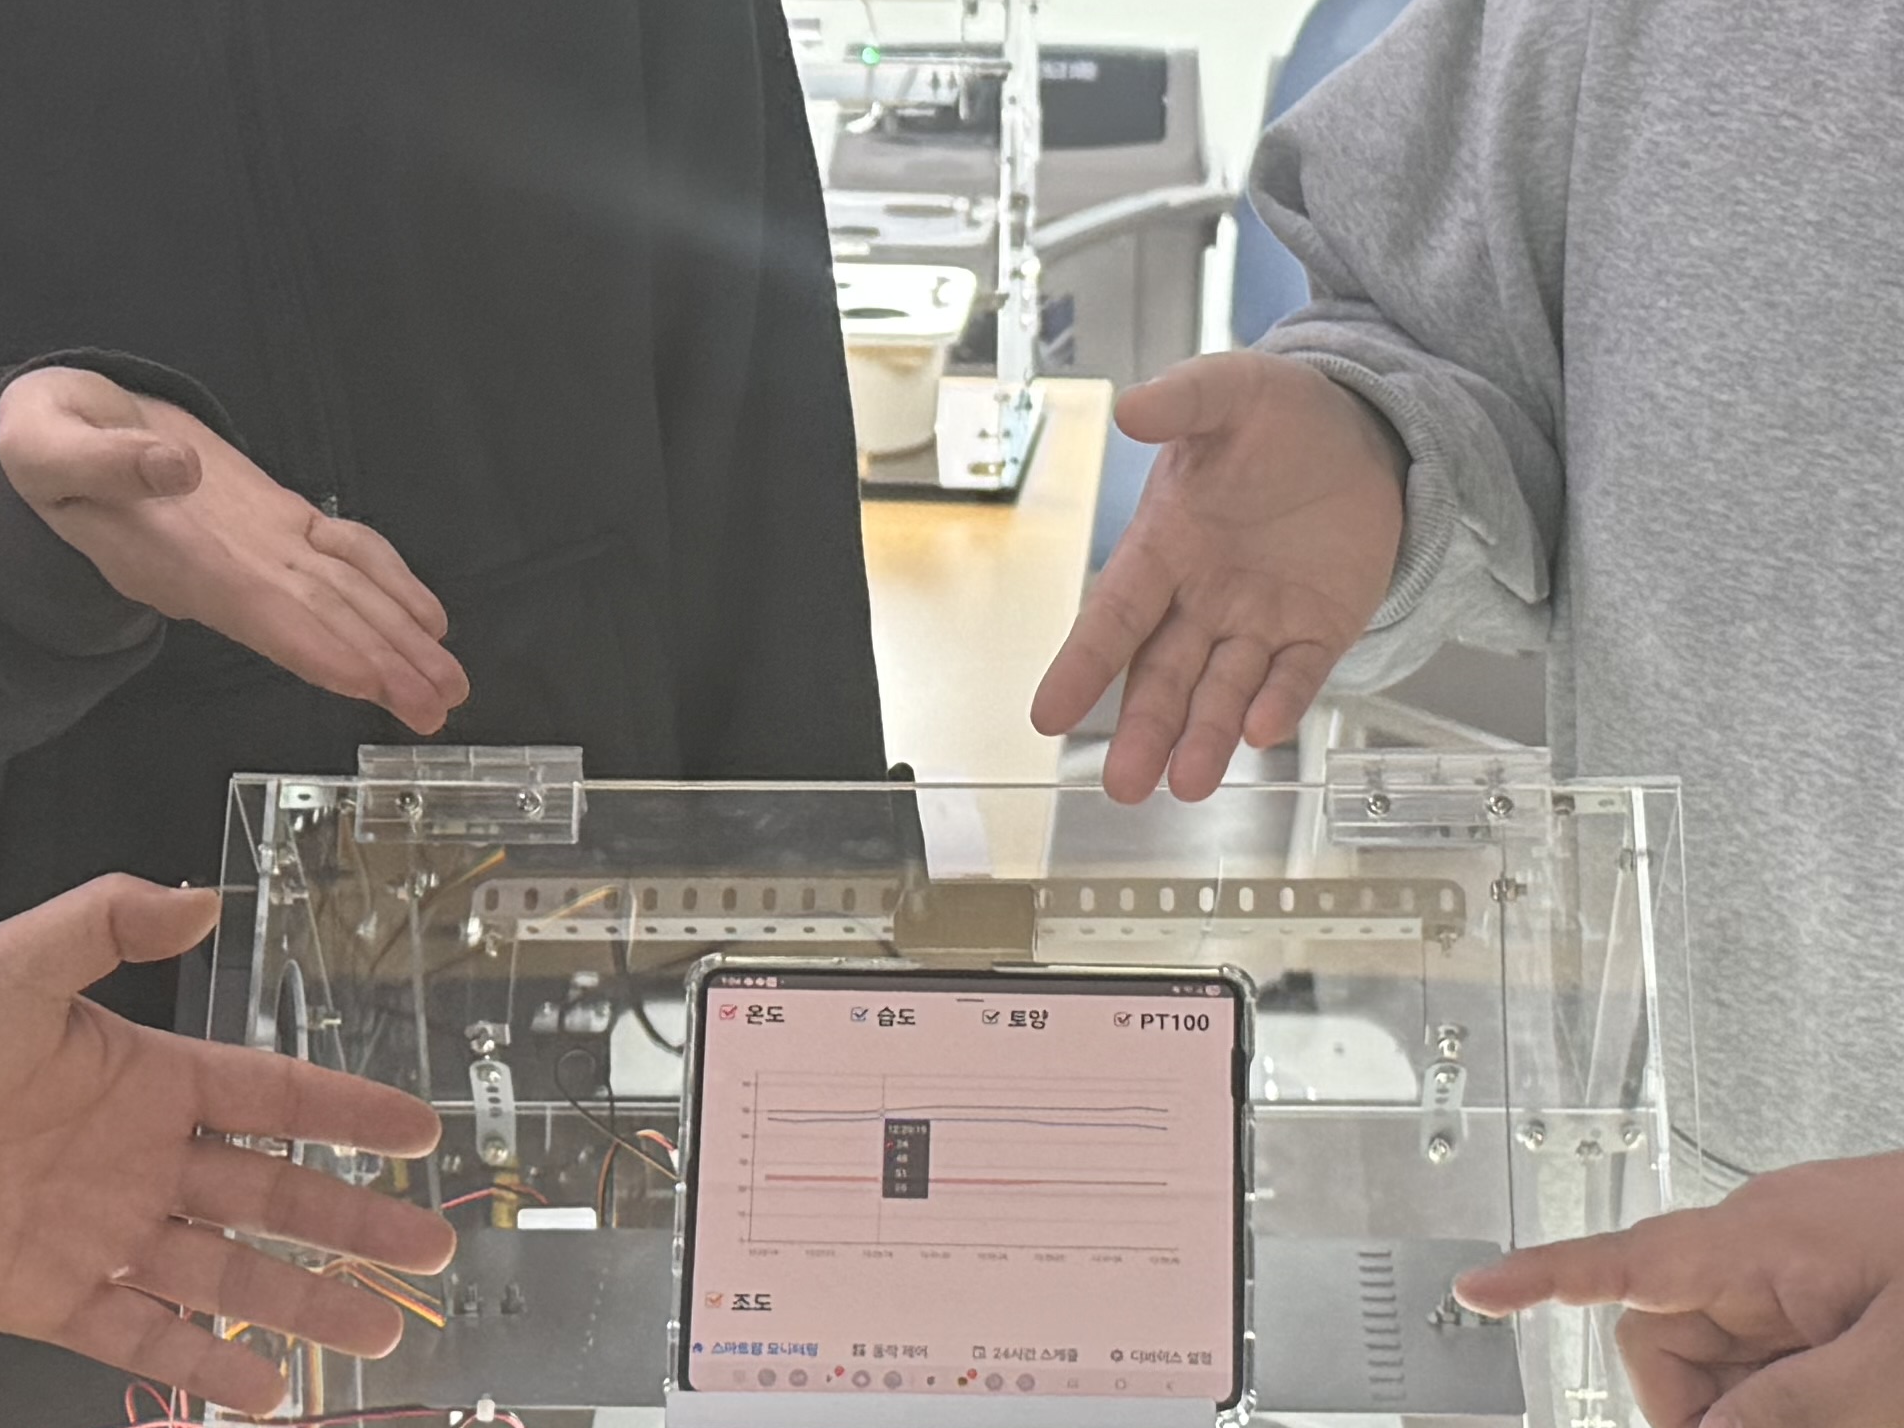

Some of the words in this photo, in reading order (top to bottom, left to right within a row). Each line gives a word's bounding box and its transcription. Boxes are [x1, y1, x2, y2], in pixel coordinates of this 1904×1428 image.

[745, 1004, 785, 1026] 온도
[876, 1006, 916, 1028] 습도
[1007, 1008, 1049, 1030] 토양
[1140, 1013, 1211, 1032] PT100
[730, 1291, 773, 1313] 조도
